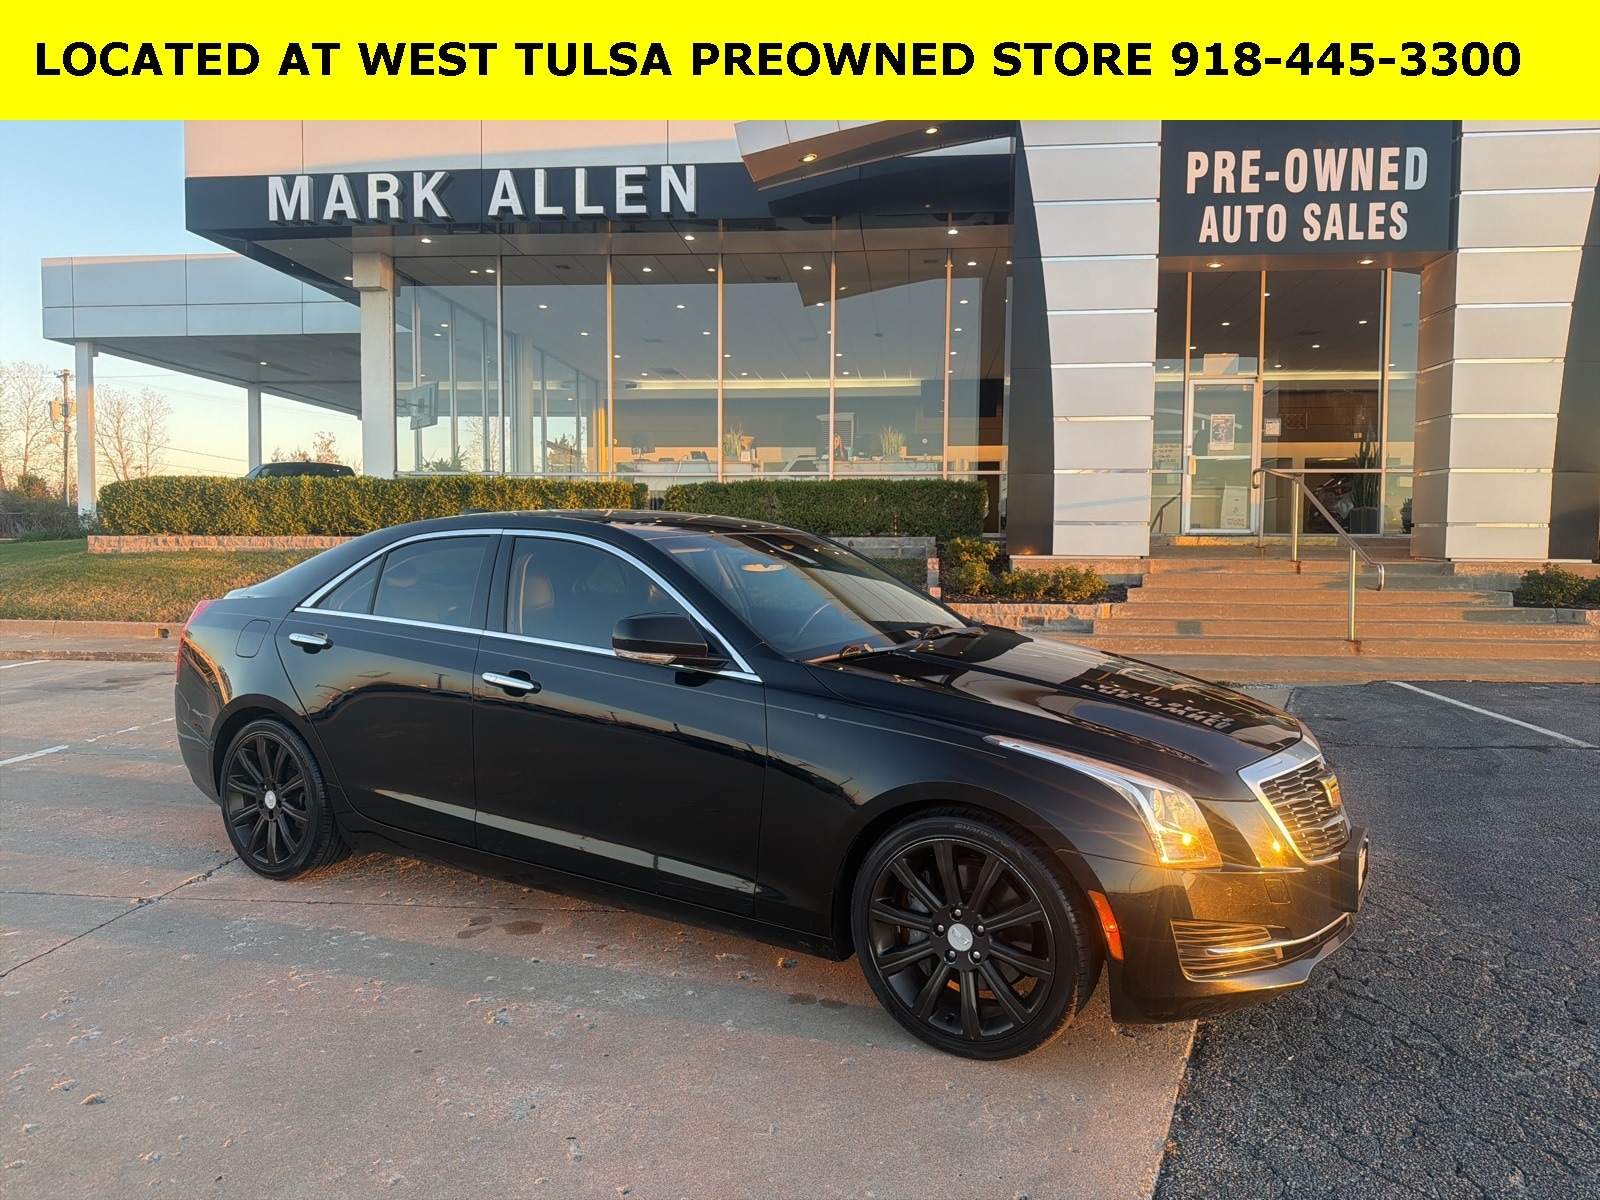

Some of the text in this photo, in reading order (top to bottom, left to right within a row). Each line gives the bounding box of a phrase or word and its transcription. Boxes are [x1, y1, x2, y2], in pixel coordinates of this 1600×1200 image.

[267, 164, 698, 222] MARK ALLEN
[1186, 146, 1430, 194] PRE-OWNED
[1198, 201, 1409, 243] AUTO SALES
